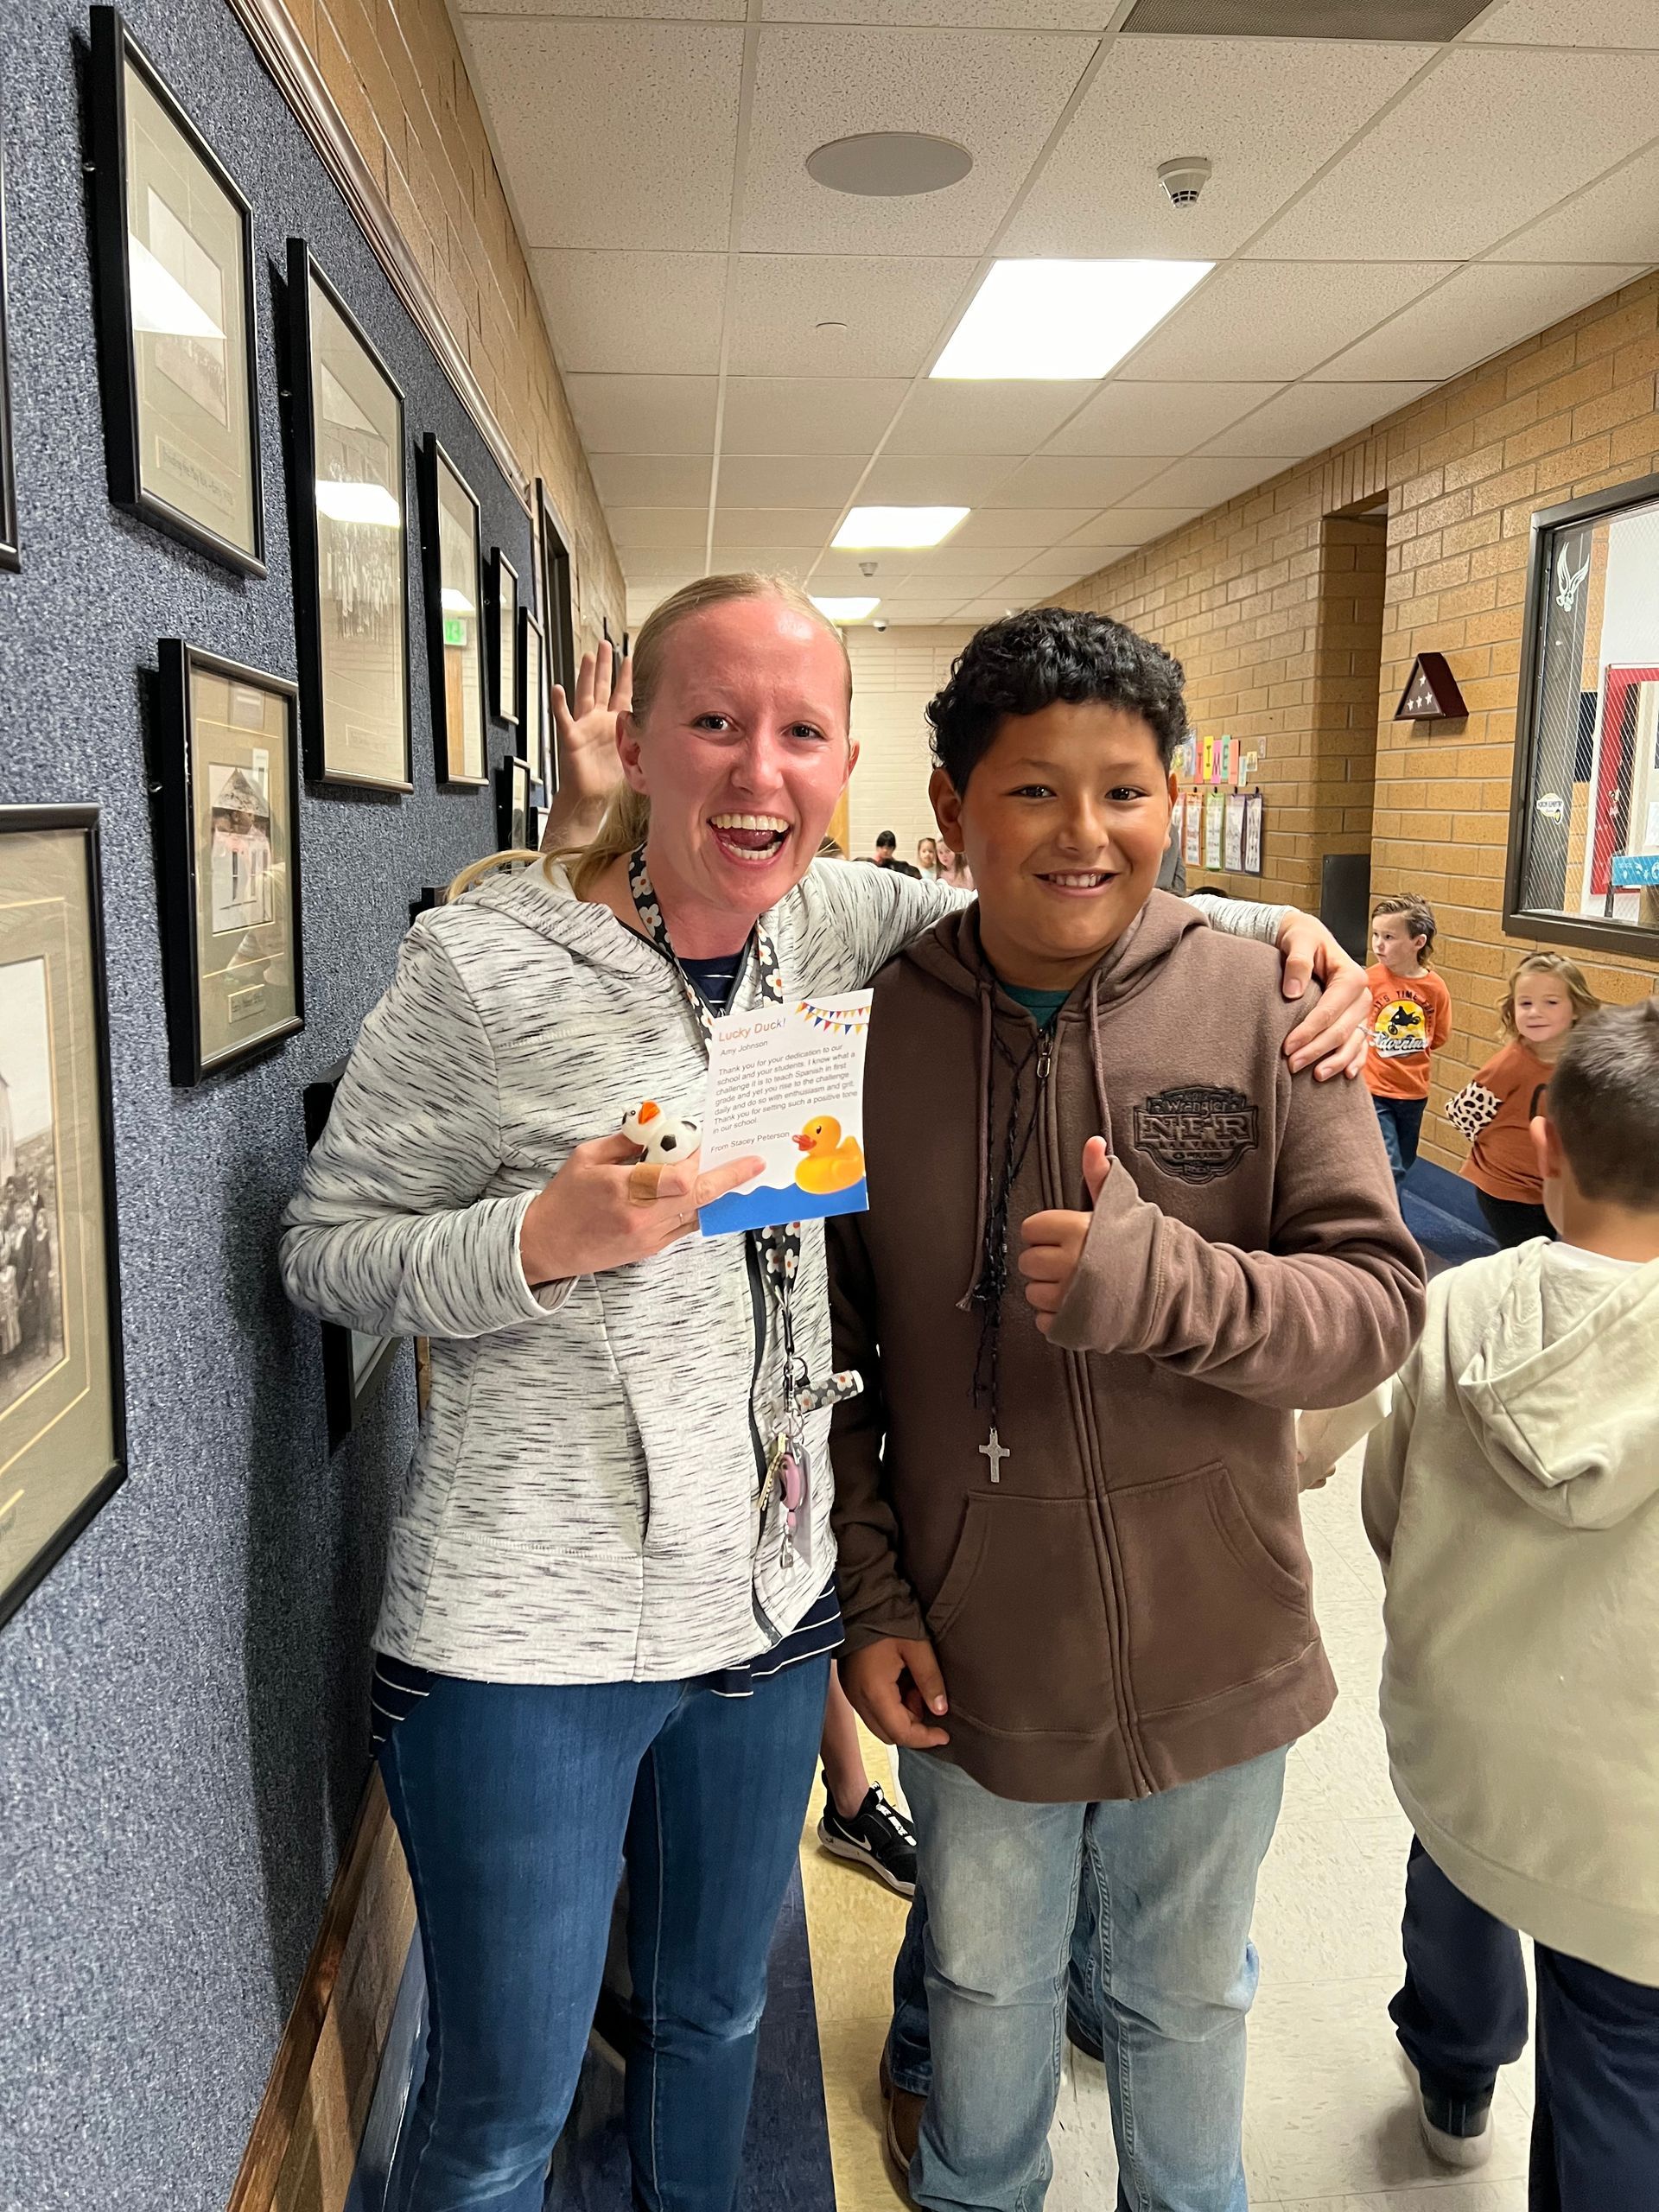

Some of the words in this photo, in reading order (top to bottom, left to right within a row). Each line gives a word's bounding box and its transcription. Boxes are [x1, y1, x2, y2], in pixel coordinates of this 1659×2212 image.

[1396, 990, 1418, 1001] TIME
[719, 1027, 751, 1042] Lucky
[754, 1018, 785, 1033] Duck!
[720, 1048, 736, 1057] Amy
[738, 1041, 768, 1052] Johnson
[717, 1074, 741, 1086] school
[742, 1071, 755, 1080] and
[757, 1067, 772, 1077] your
[812, 1057, 830, 1065] know
[832, 1052, 849, 1061] what
[719, 1065, 740, 1076] Thank
[742, 1063, 755, 1072] you
[768, 1056, 784, 1066] your
[785, 1049, 822, 1061] dedication
[715, 1083, 750, 1096] challenge
[773, 1072, 793, 1083] teach
[795, 1067, 823, 1078] Spanish
[715, 1095, 735, 1107] grade
[737, 1090, 751, 1100] and
[753, 1088, 763, 1098] yet
[765, 1086, 778, 1095] you
[779, 1082, 792, 1090] rise
[816, 1072, 849, 1083] challenge
[715, 1106, 731, 1116] daily
[733, 1102, 746, 1110] and
[769, 1093, 783, 1102] with
[785, 1086, 825, 1098] enthusiasm
[826, 1083, 841, 1091] and
[715, 1114, 735, 1125] Thank
[737, 1111, 750, 1120] you
[762, 1103, 786, 1113] setting
[788, 1099, 805, 1108] such
[813, 1093, 841, 1105] positive
[1166, 1099, 1229, 1118] Wrangler
[721, 1123, 733, 1132] our
[711, 1143, 729, 1154] From
[730, 1137, 755, 1147] Stacey
[757, 1131, 790, 1142] Peterson
